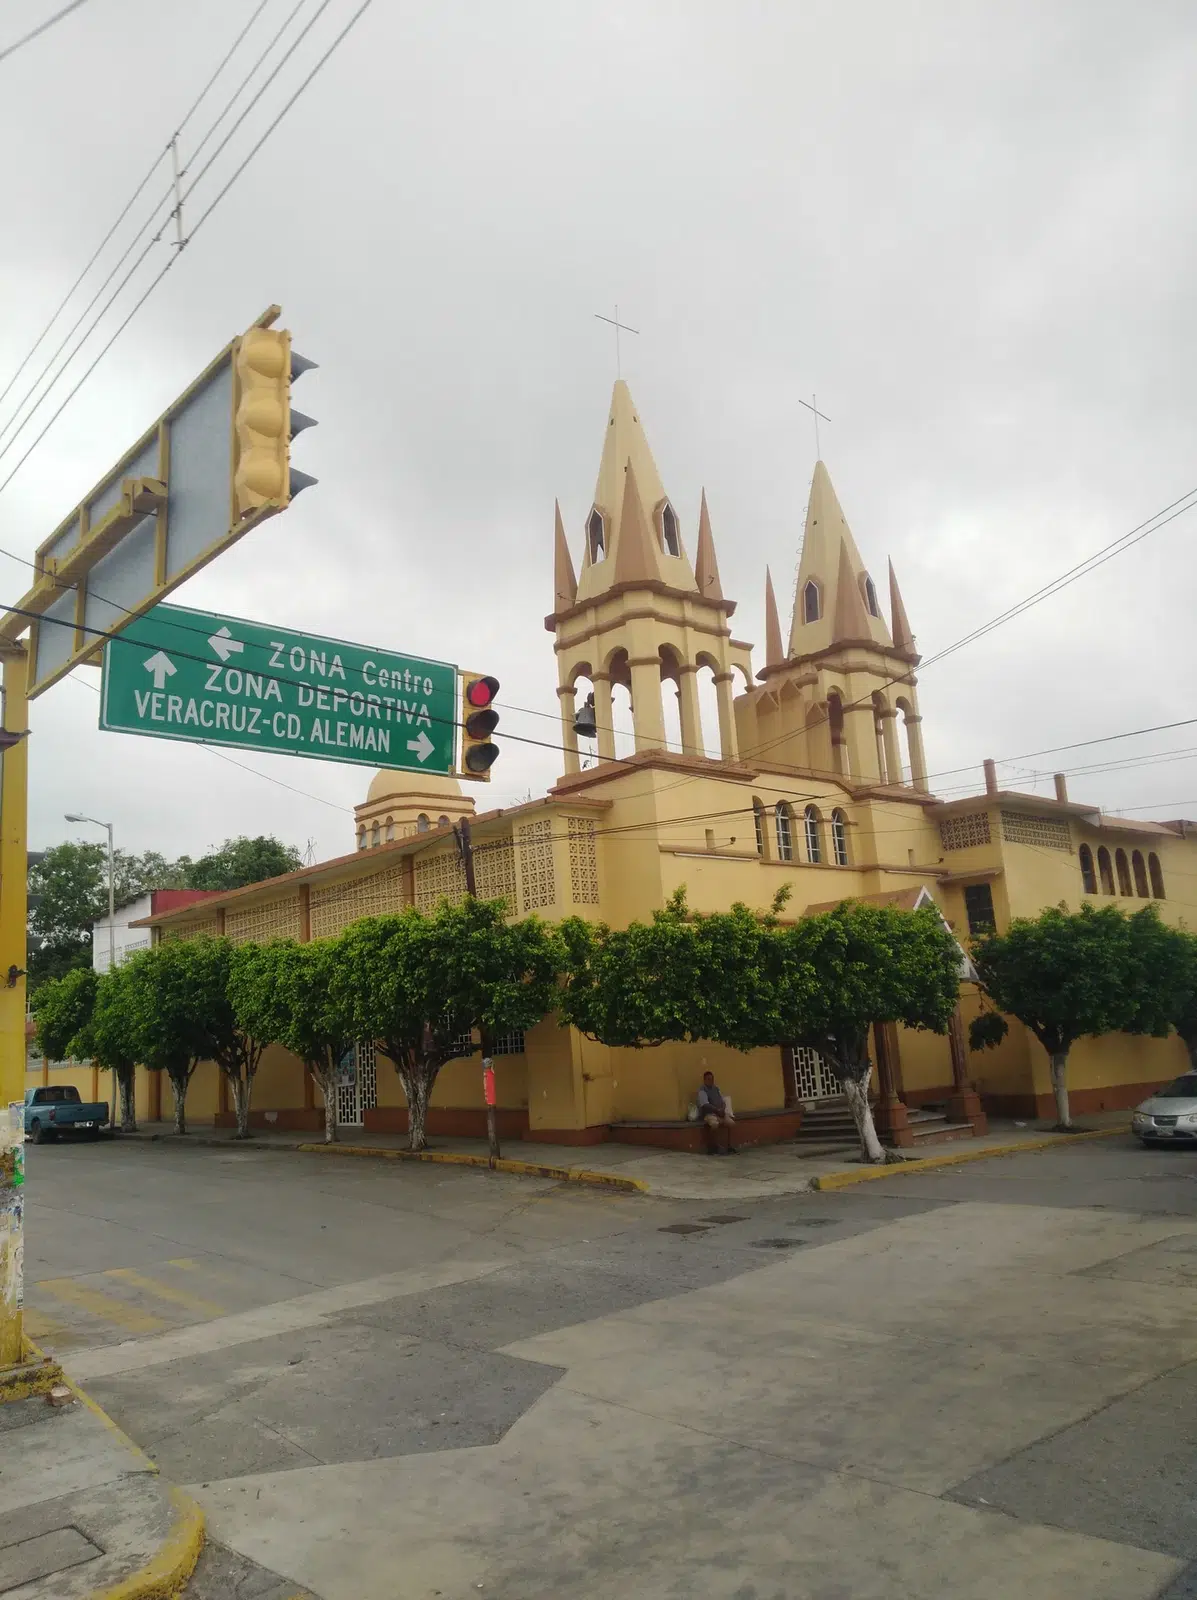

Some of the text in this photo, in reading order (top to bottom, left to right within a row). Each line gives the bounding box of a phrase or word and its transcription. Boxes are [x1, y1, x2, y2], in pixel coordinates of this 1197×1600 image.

[205, 664, 432, 728] ZONA DEPORTIVA
[269, 642, 433, 696] ZONA Centro
[134, 691, 391, 753] VERACRUZ-CD. ALEMAN
